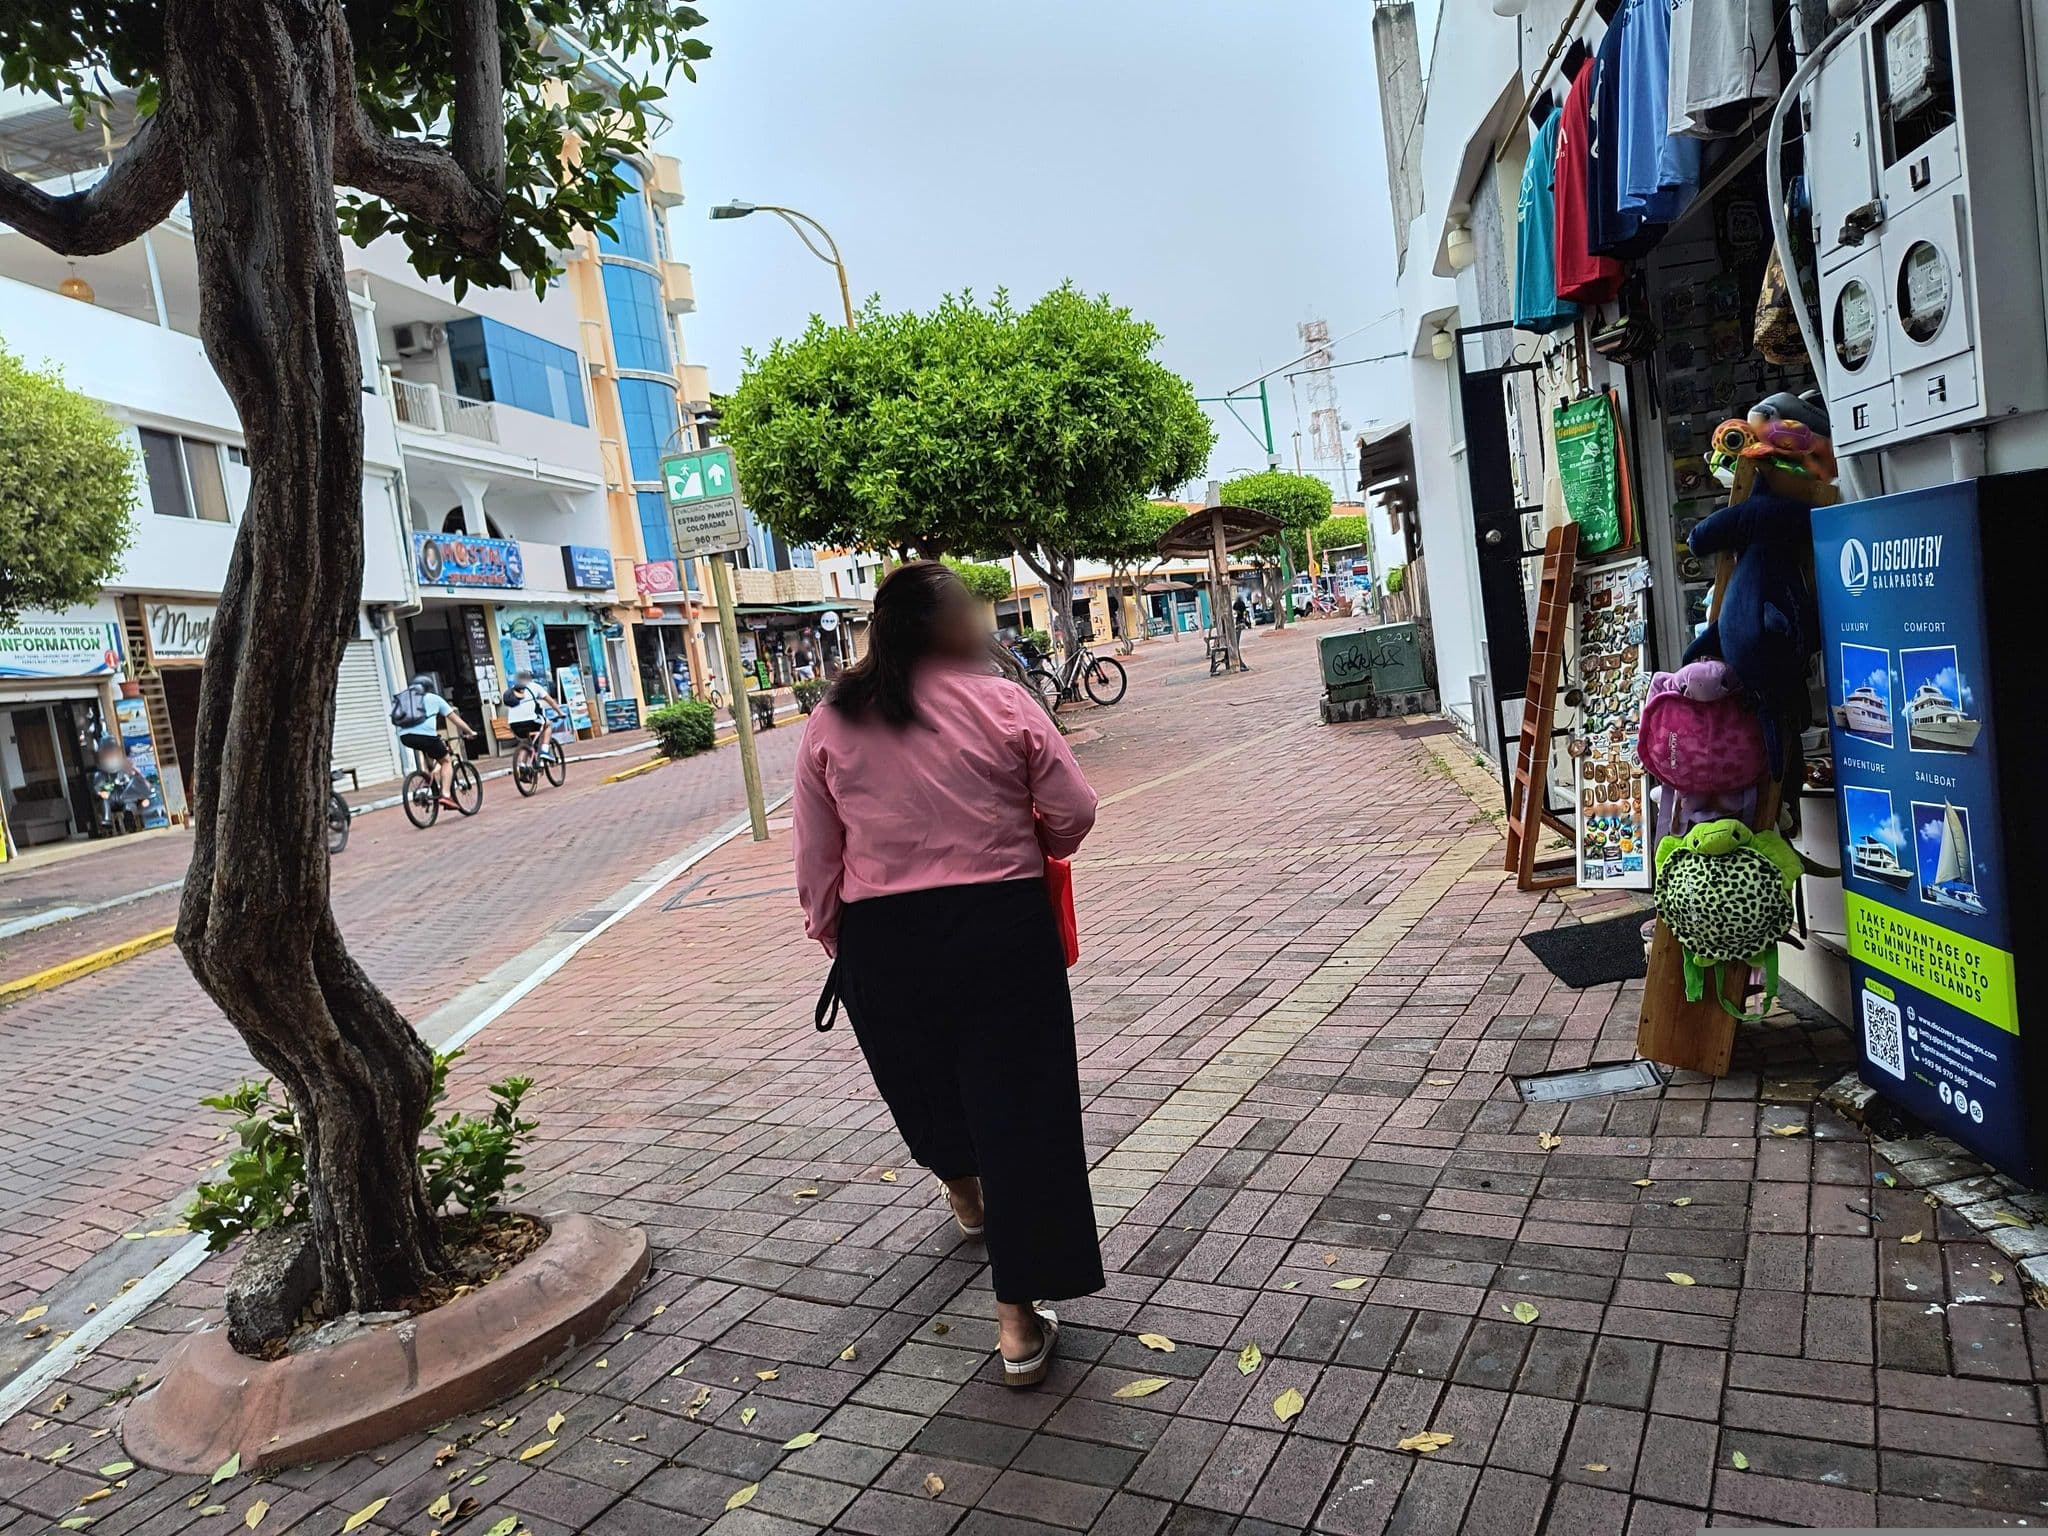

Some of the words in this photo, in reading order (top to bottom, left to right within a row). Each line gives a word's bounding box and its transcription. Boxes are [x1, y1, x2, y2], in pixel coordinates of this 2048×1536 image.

[677, 513, 706, 526] ESTADIO
[707, 509, 734, 521] PAMPAS
[686, 521, 727, 533] COLORADAS
[1872, 534, 1943, 572] DISCOVERY
[1873, 571, 1924, 589] GALÁPAGOS
[60, 626, 86, 636] TOURS
[1840, 622, 1870, 632] LUXURY
[1904, 622, 1946, 633] COMFORT
[1843, 756, 1886, 774] ADVENTURE
[1915, 771, 1957, 789] SAILBOAT
[1860, 908, 1886, 929] TAKE
[1890, 921, 1960, 961] ADVANTAGE
[1965, 952, 1981, 969] OF
[1856, 921, 1880, 941] LAST
[1884, 933, 1925, 962] MINUTE
[1929, 953, 1967, 980] DEALS
[1971, 970, 1989, 989] TO
[1863, 939, 1901, 966] CRUISE
[1904, 957, 1925, 977] THE
[1929, 969, 1982, 1003] ISLANDS
